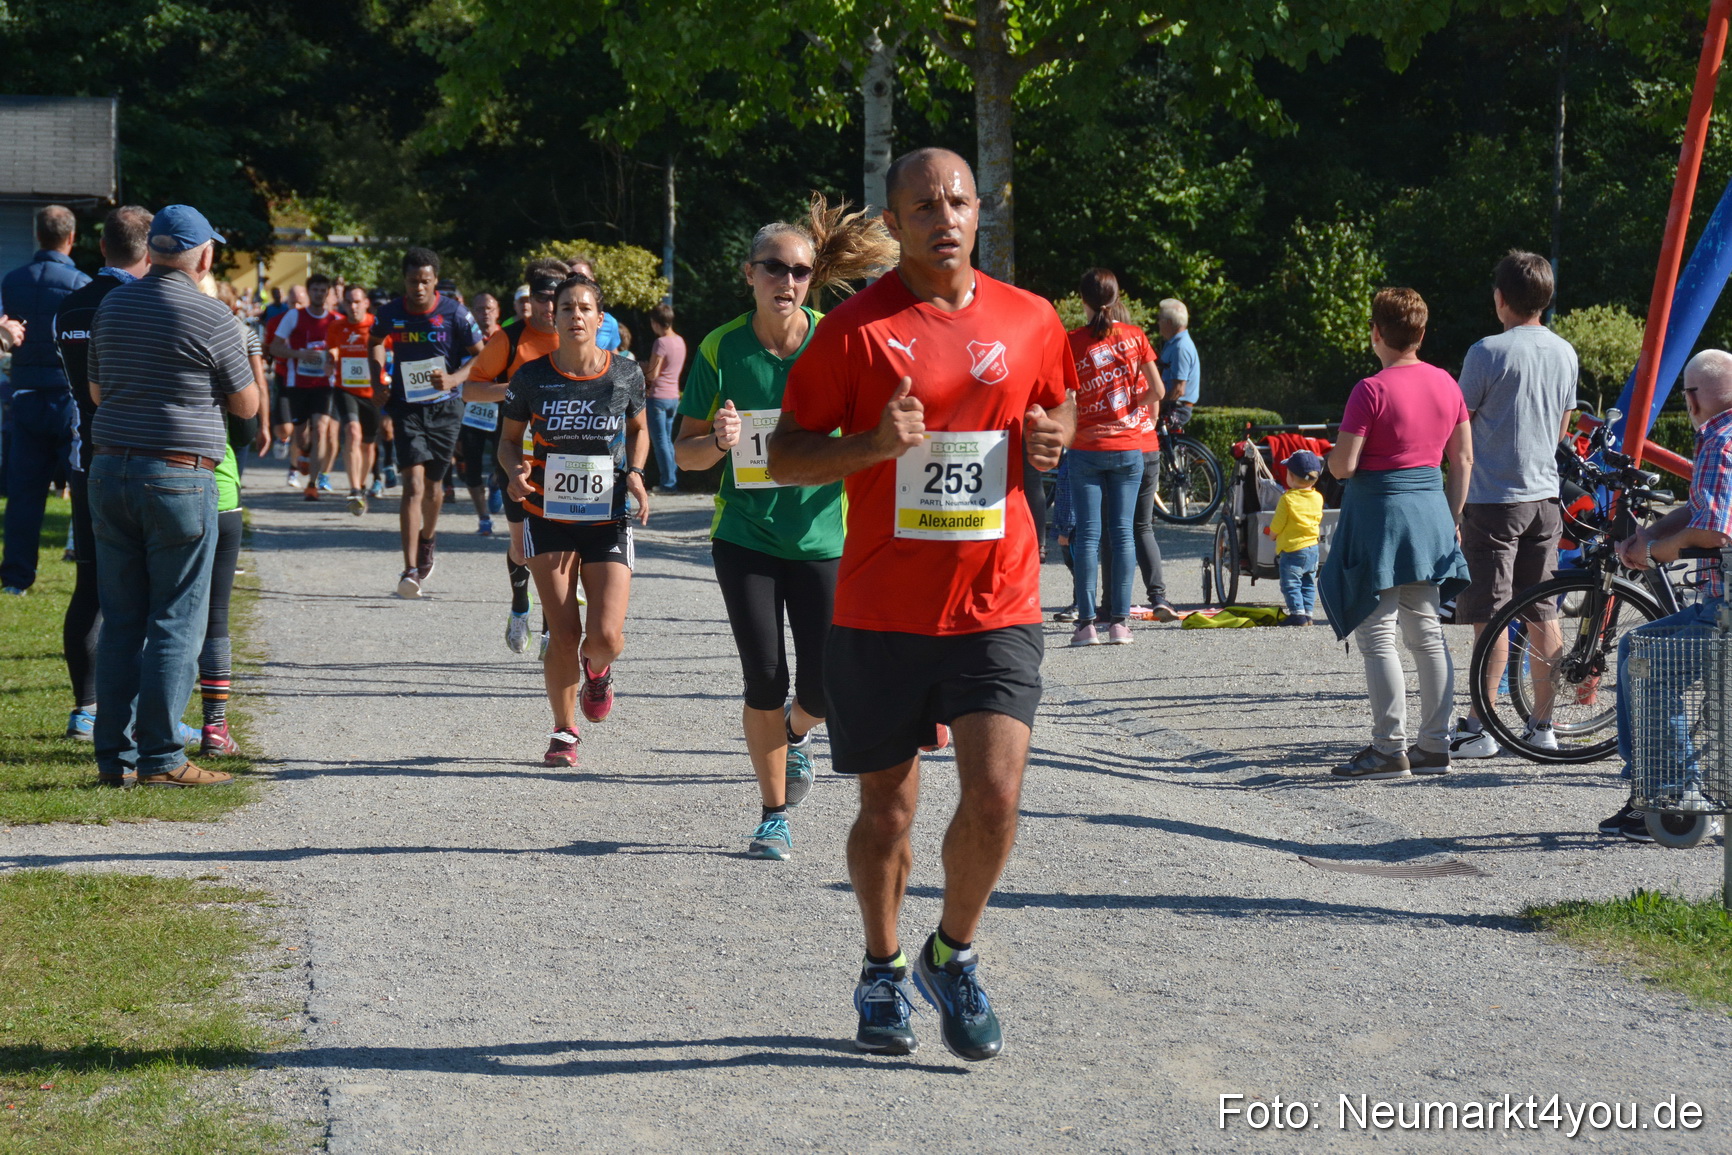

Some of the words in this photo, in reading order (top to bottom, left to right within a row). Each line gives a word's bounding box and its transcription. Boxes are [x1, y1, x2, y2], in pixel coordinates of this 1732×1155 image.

[391, 331, 447, 343] MENSCH
[350, 365, 363, 376] 80
[408, 370, 433, 385] 306
[469, 404, 494, 419] 2318
[541, 400, 596, 415] HECK
[546, 415, 622, 431] DESIGN
[931, 442, 979, 453] BOCK
[565, 461, 595, 469] BOCK
[554, 473, 603, 494] 2018
[923, 462, 983, 494] 253
[569, 504, 586, 514] Ulla
[919, 514, 986, 527] Alexander
